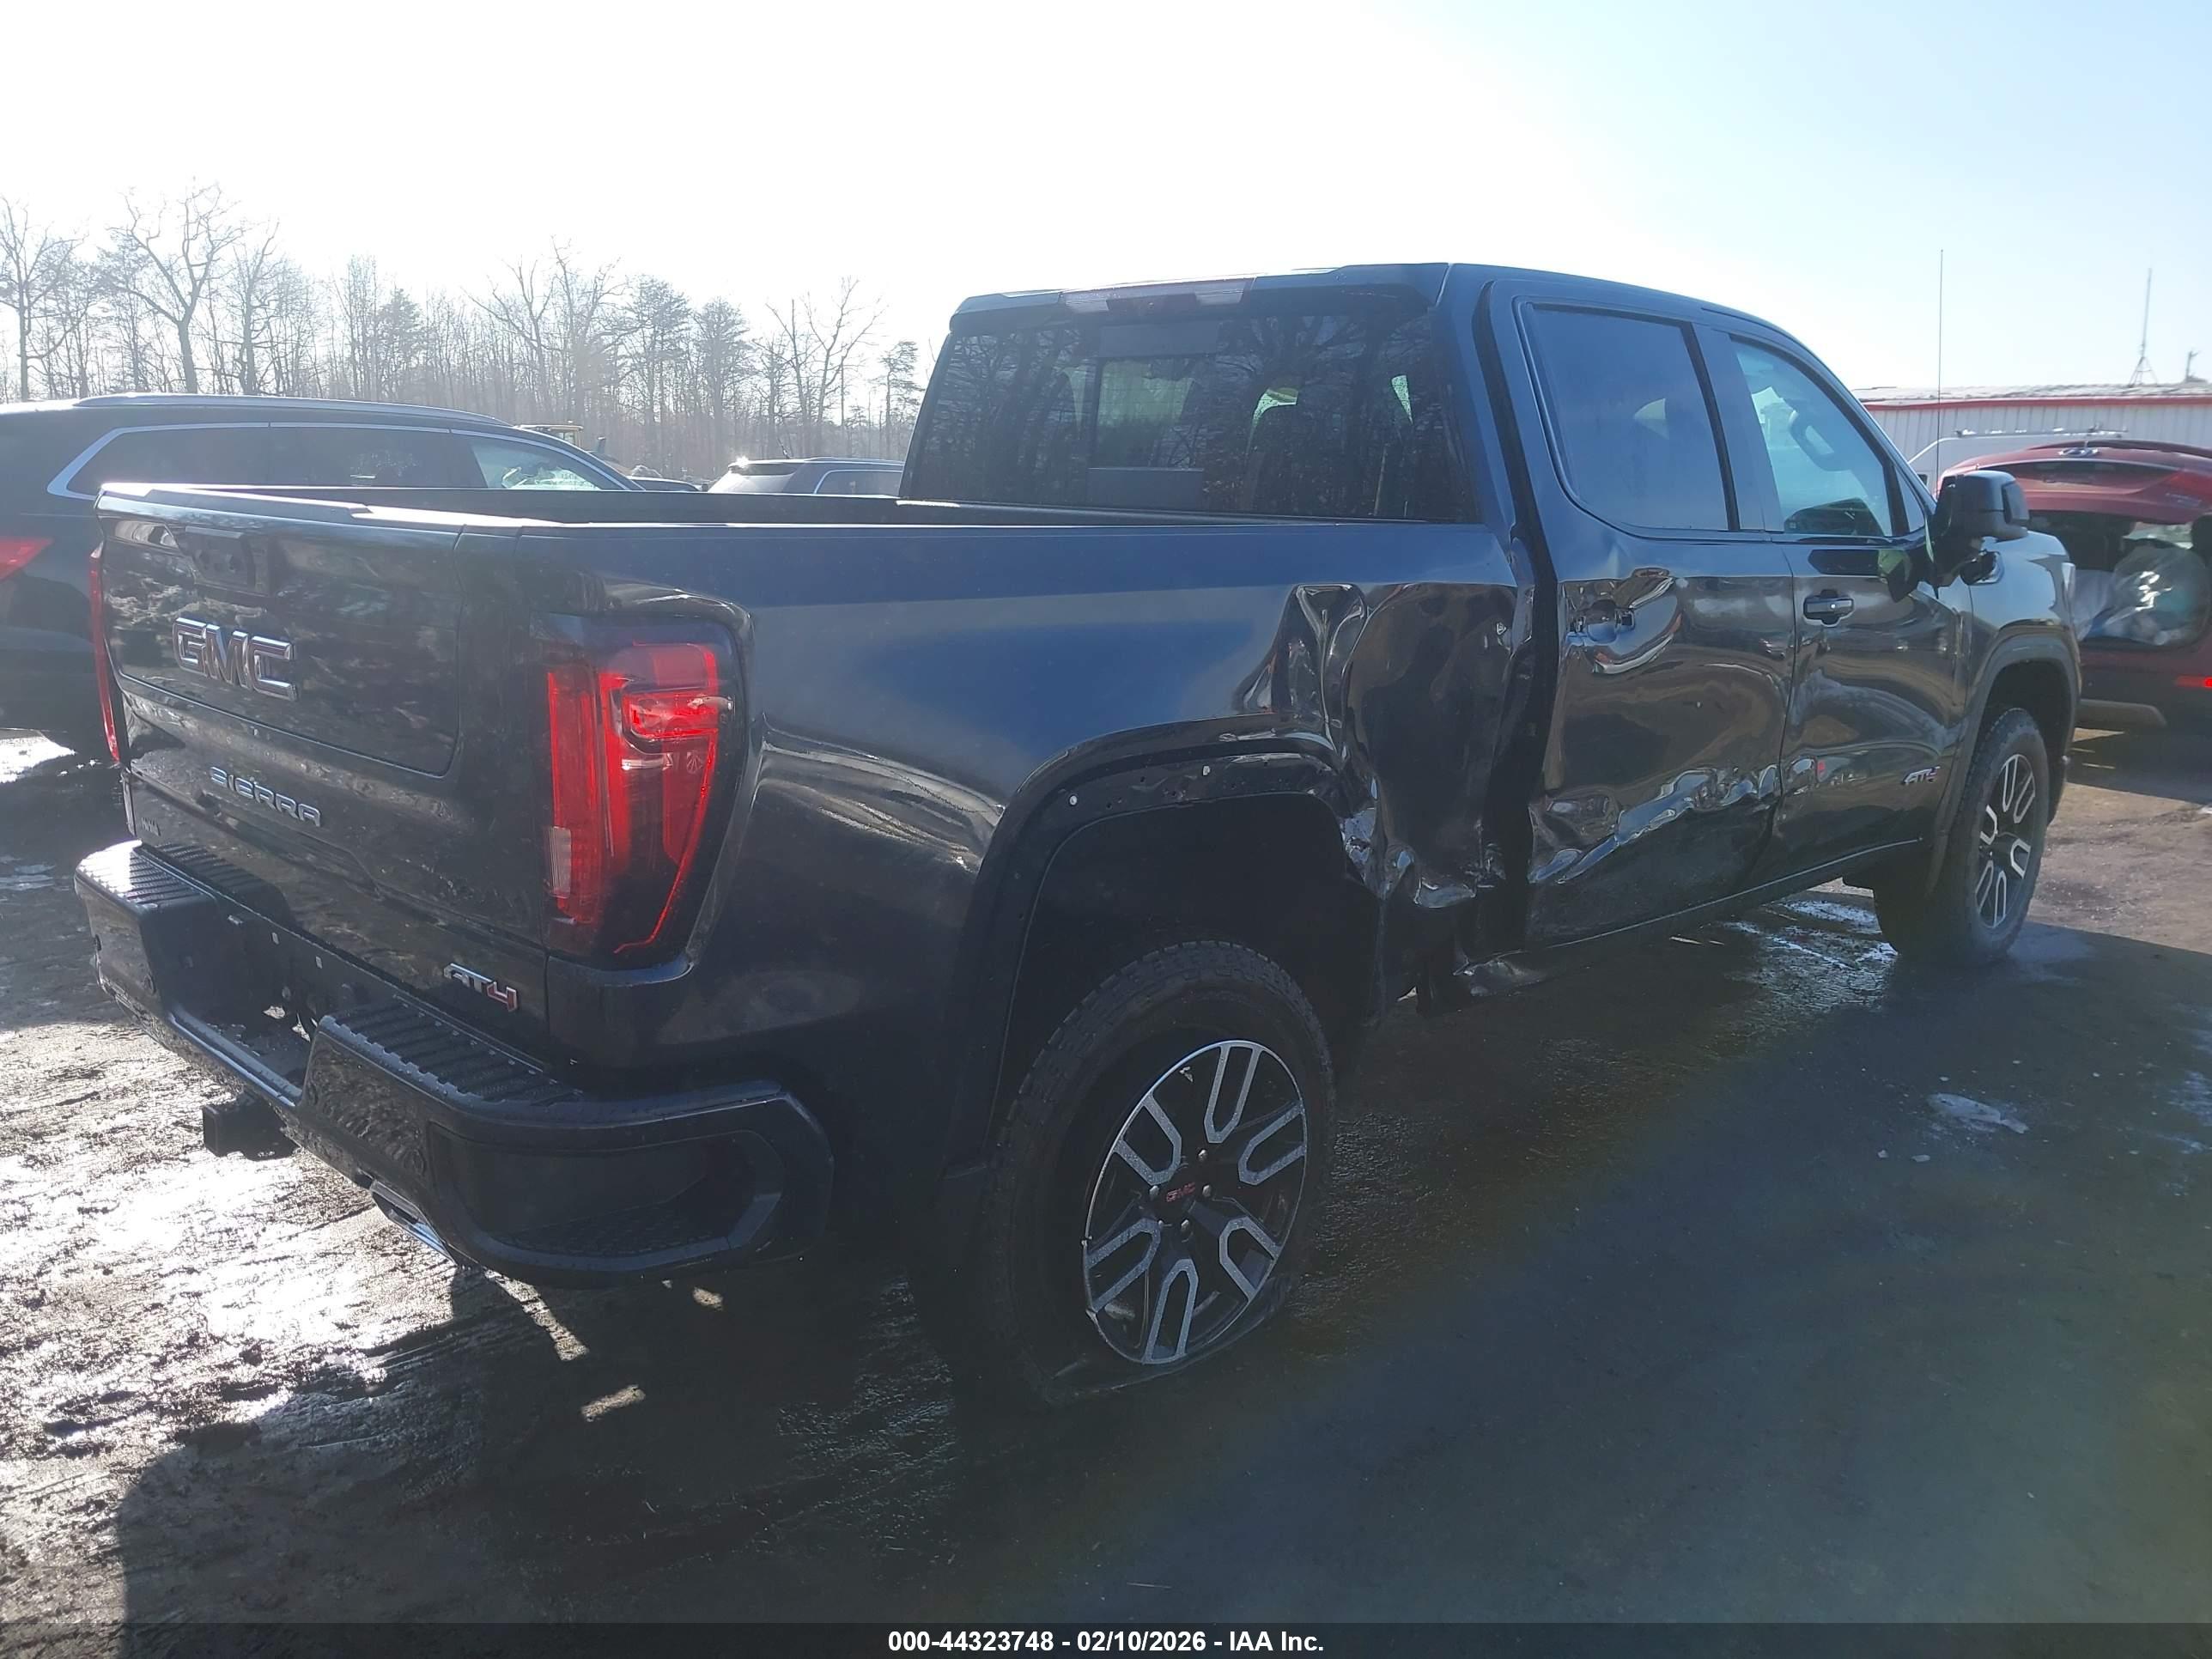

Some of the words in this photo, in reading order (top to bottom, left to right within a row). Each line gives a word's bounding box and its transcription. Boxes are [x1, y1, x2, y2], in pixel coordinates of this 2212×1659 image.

[173, 617, 297, 701] GMC
[210, 766, 321, 827] SIERRA
[443, 963, 518, 1012] AT4
